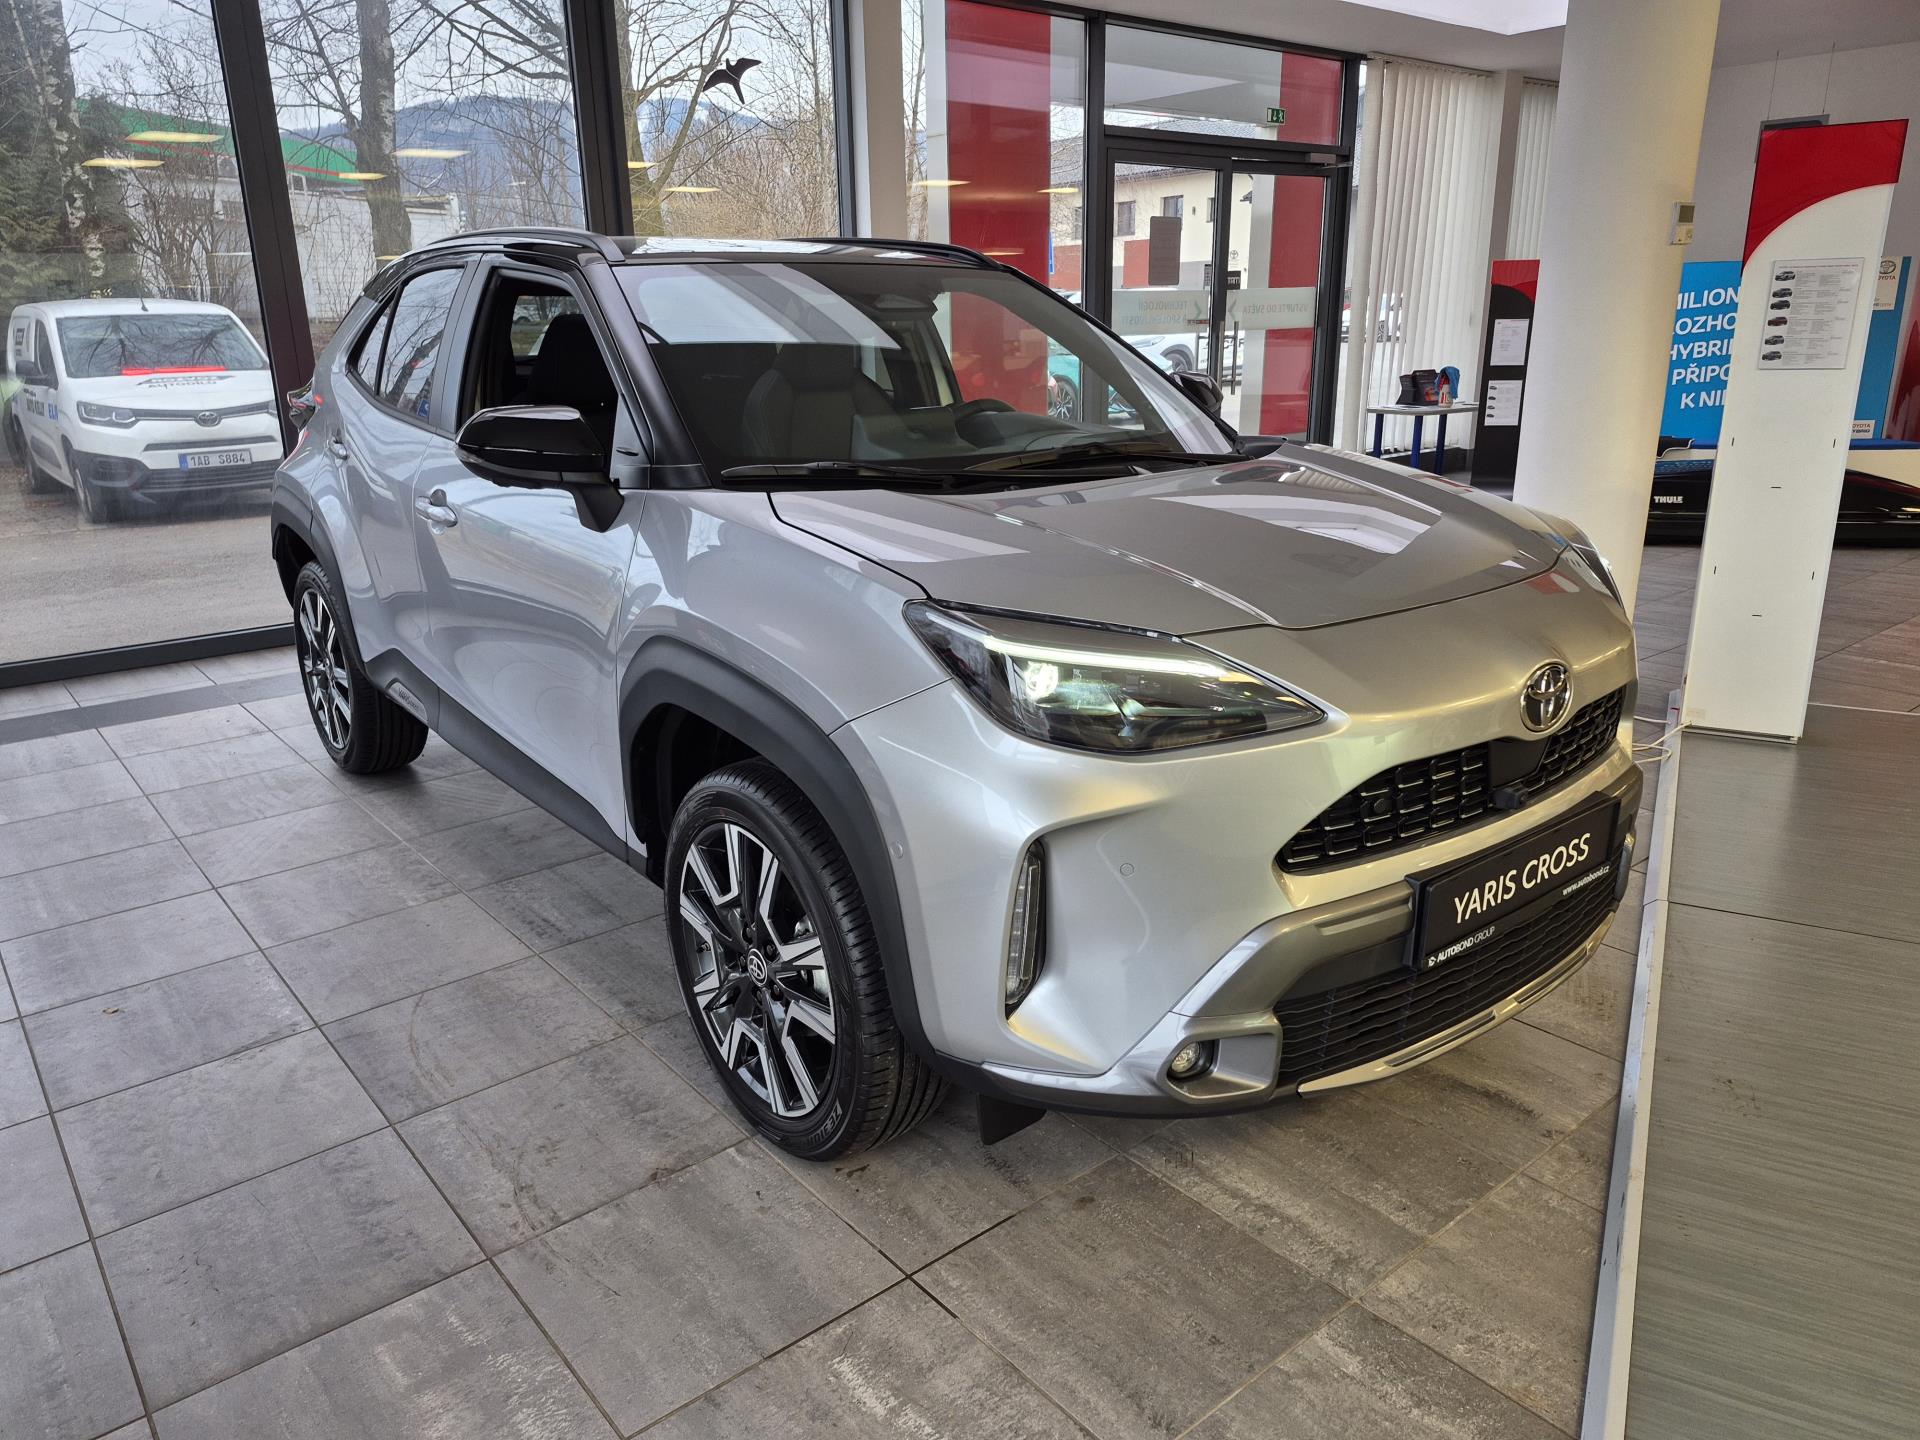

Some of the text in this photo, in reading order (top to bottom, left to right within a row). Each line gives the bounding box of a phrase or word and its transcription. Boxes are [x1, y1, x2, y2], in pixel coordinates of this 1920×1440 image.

[1673, 312, 1737, 335] OZHO
[1680, 391, 1695, 410] K
[1653, 495, 1684, 504] THULE
[1454, 832, 1591, 924] YARIS CROSS
[1562, 865, 1610, 896] www.autobond.cz
[1436, 926, 1496, 963] AUTOBOND GROUP
